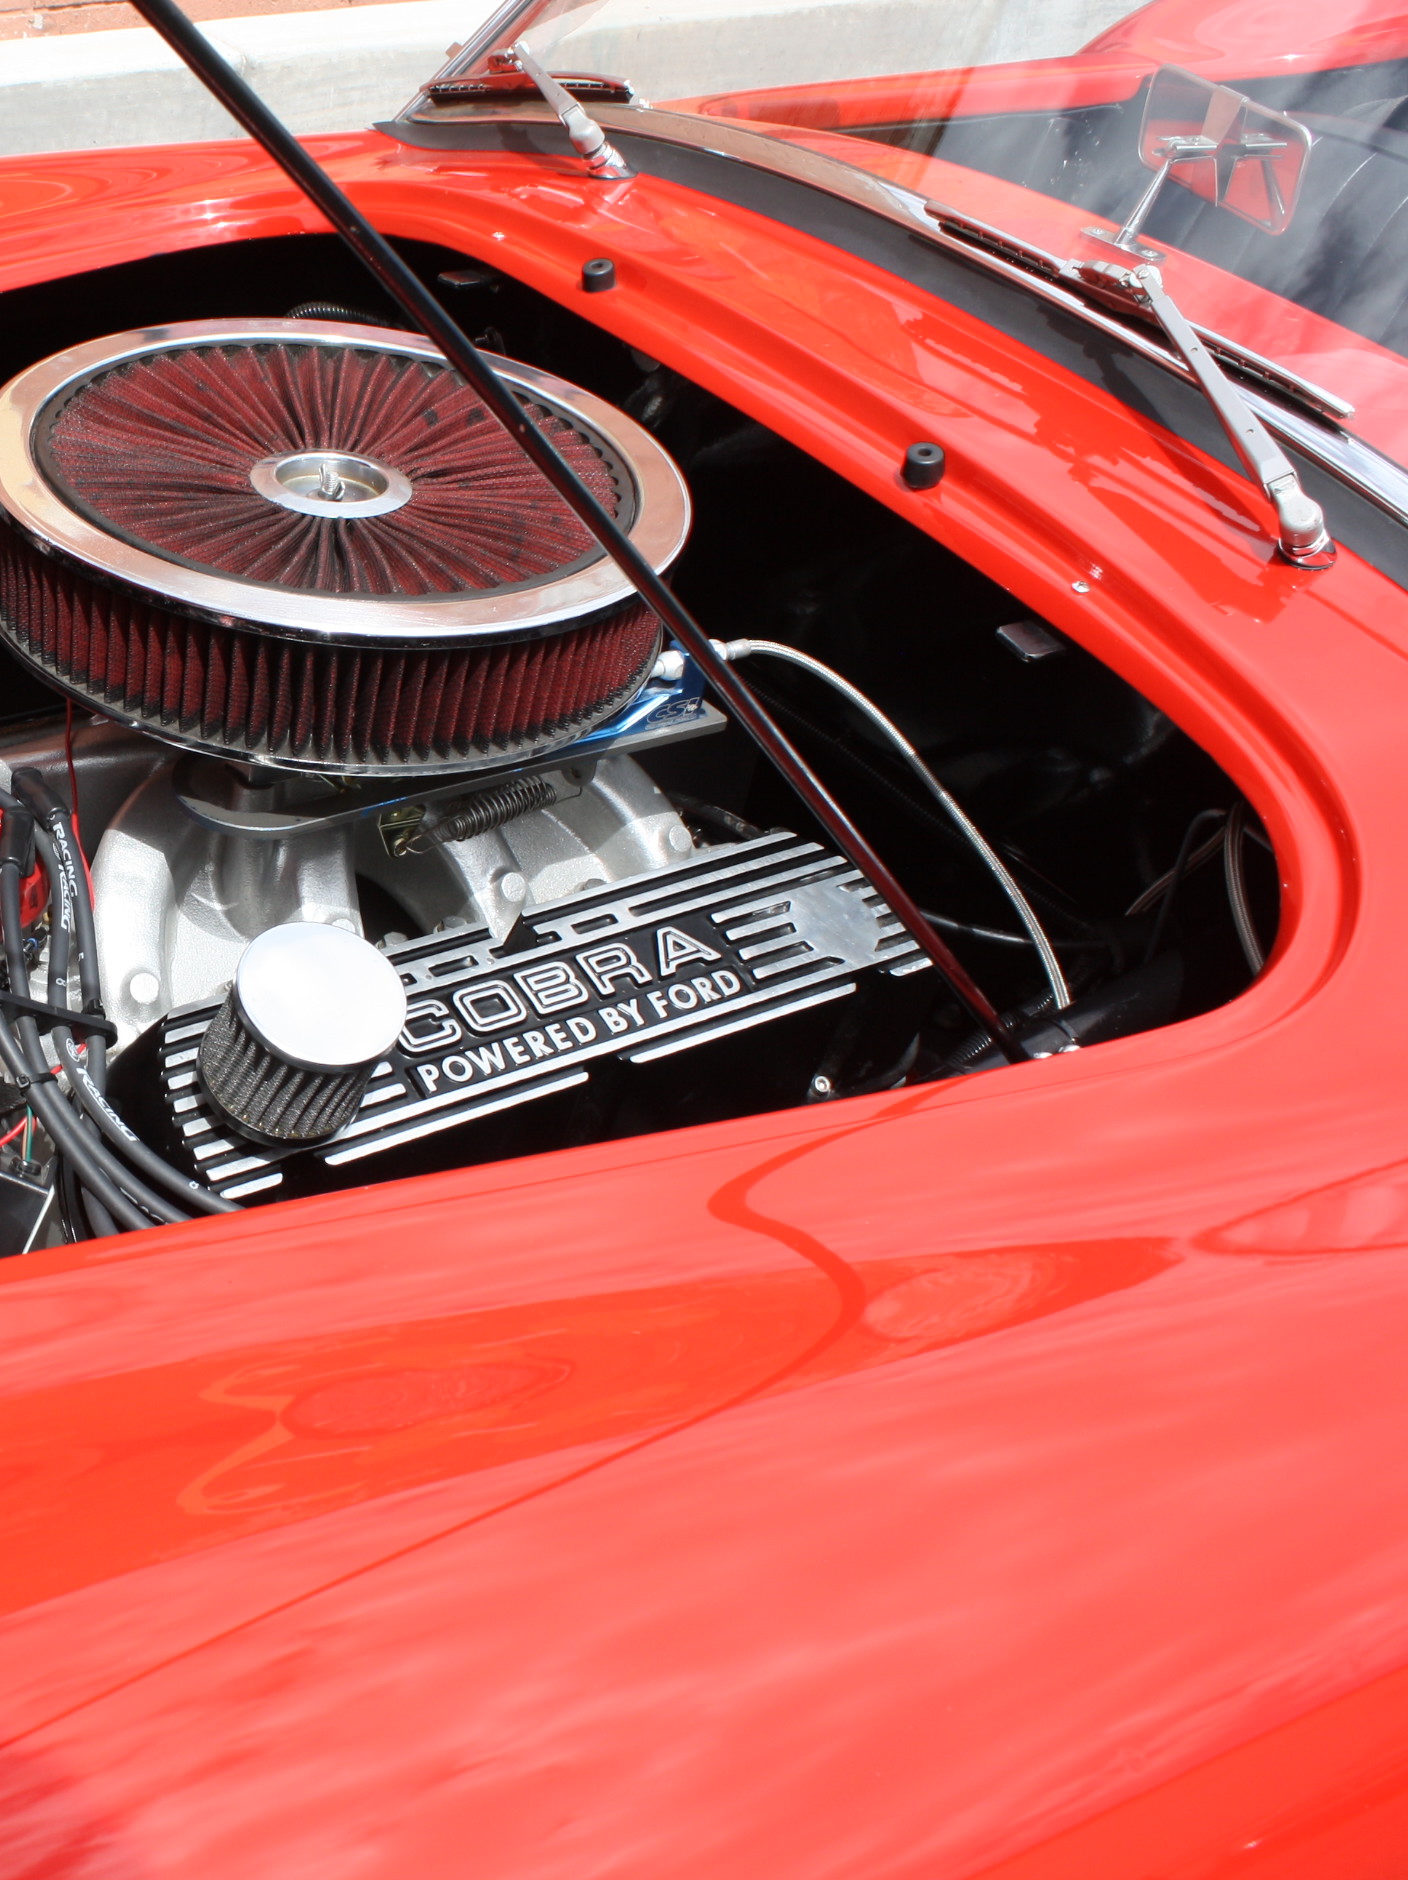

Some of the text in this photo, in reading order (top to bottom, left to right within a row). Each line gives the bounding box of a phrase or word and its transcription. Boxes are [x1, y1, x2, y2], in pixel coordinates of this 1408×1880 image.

[53, 822, 78, 898] RACING
[396, 925, 723, 1053] COBRA
[415, 969, 742, 1095] POWERED BY FORD
[76, 1067, 141, 1142] RACING
